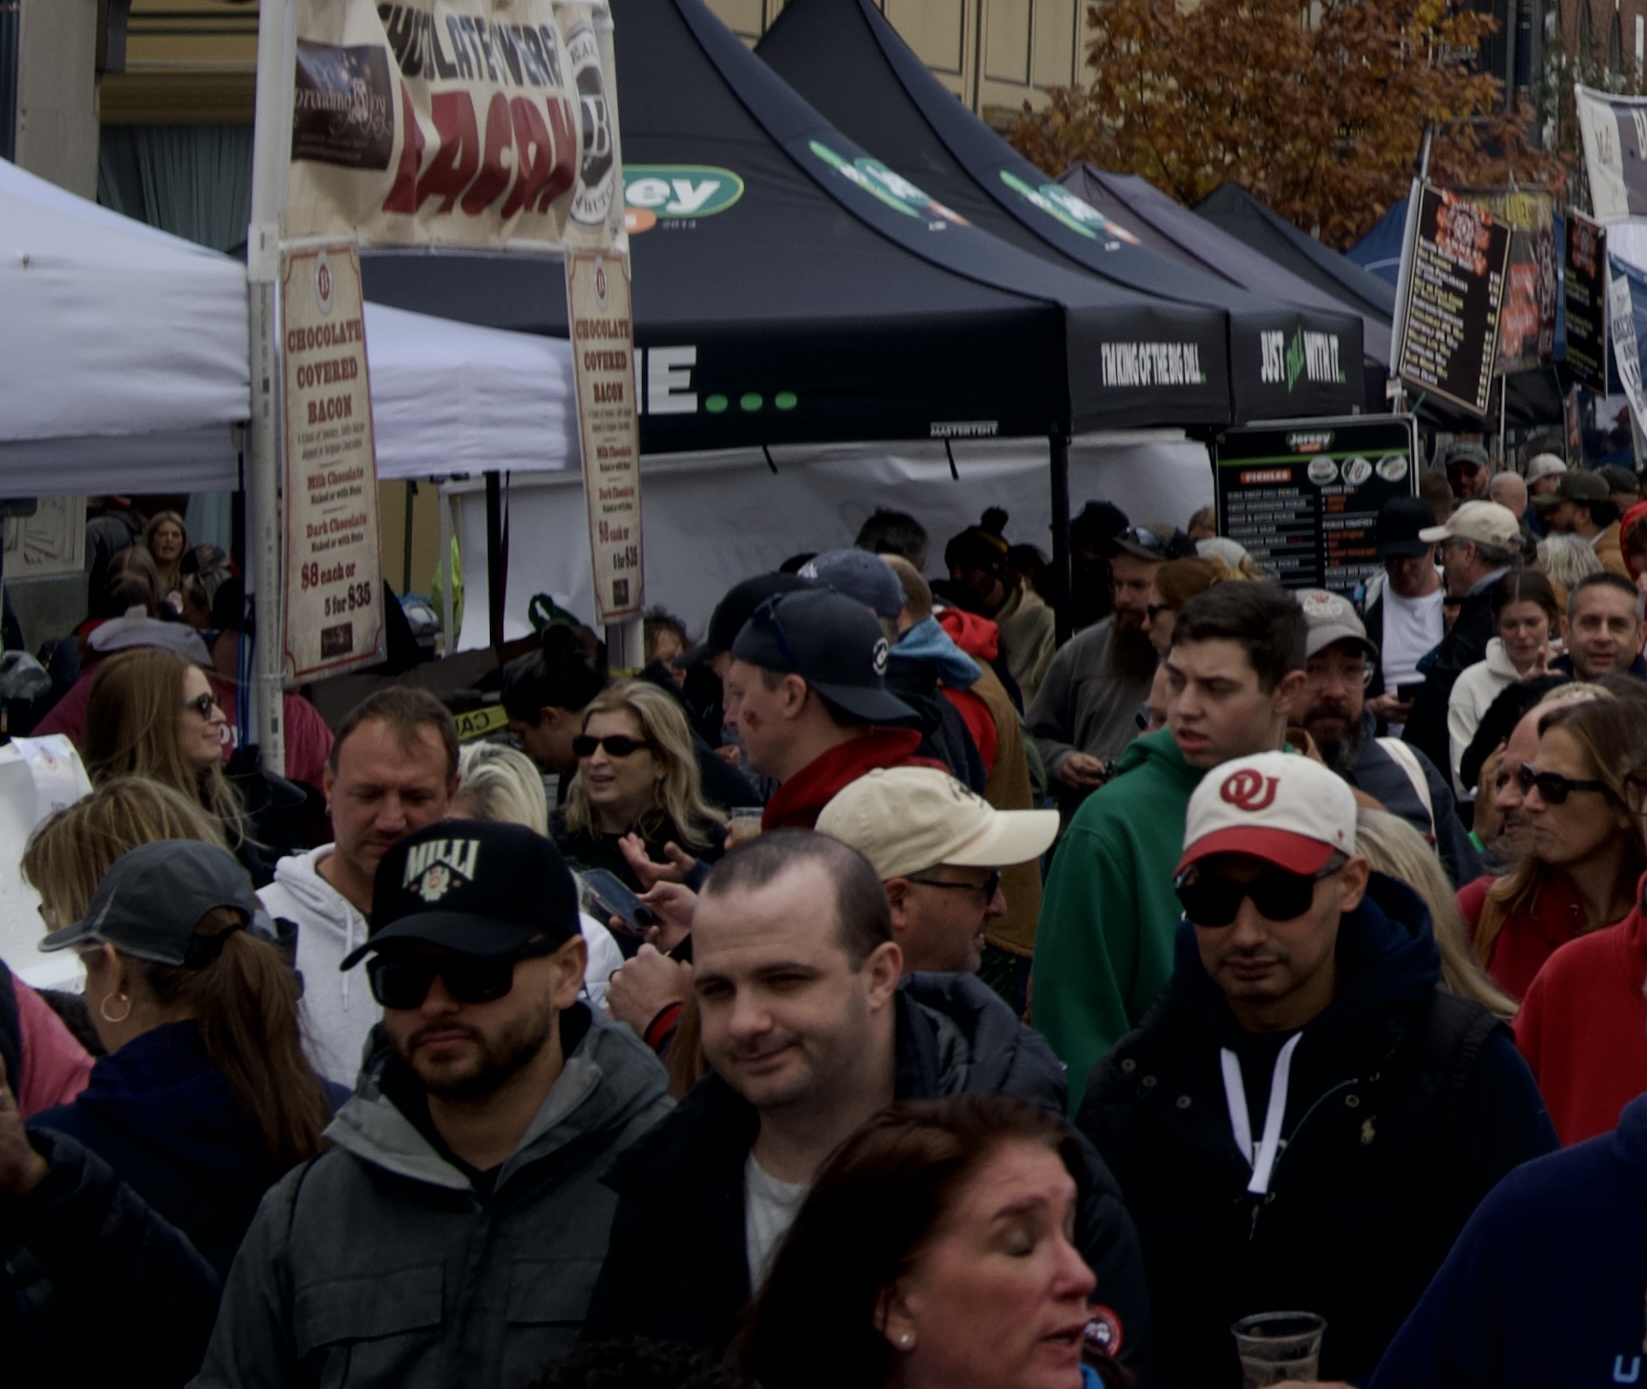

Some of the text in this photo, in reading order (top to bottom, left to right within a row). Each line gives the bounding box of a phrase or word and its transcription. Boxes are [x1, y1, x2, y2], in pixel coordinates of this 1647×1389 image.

[287, 318, 362, 354] CHOCOLATE
[575, 317, 630, 340] CHOCOLATE
[584, 350, 627, 372] COVERED
[1117, 342, 1139, 387] KING
[1139, 342, 1152, 386] OF
[1151, 342, 1168, 385] THE
[1168, 342, 1184, 385] BIG
[1261, 329, 1285, 384] JUST
[1303, 330, 1331, 383] WITH
[297, 356, 358, 389] COVERED
[593, 381, 624, 403] BACON
[307, 394, 352, 425] BACON
[1289, 430, 1331, 446] Jersey
[307, 466, 364, 491] Milk Chocolate
[336, 487, 349, 501] with
[306, 512, 368, 540] Dark Chocolate
[337, 535, 350, 548] with
[301, 561, 356, 590] $8 each or
[324, 580, 372, 617] 5 for $35
[1221, 768, 1281, 811] OU
[402, 838, 481, 889] MILLI
